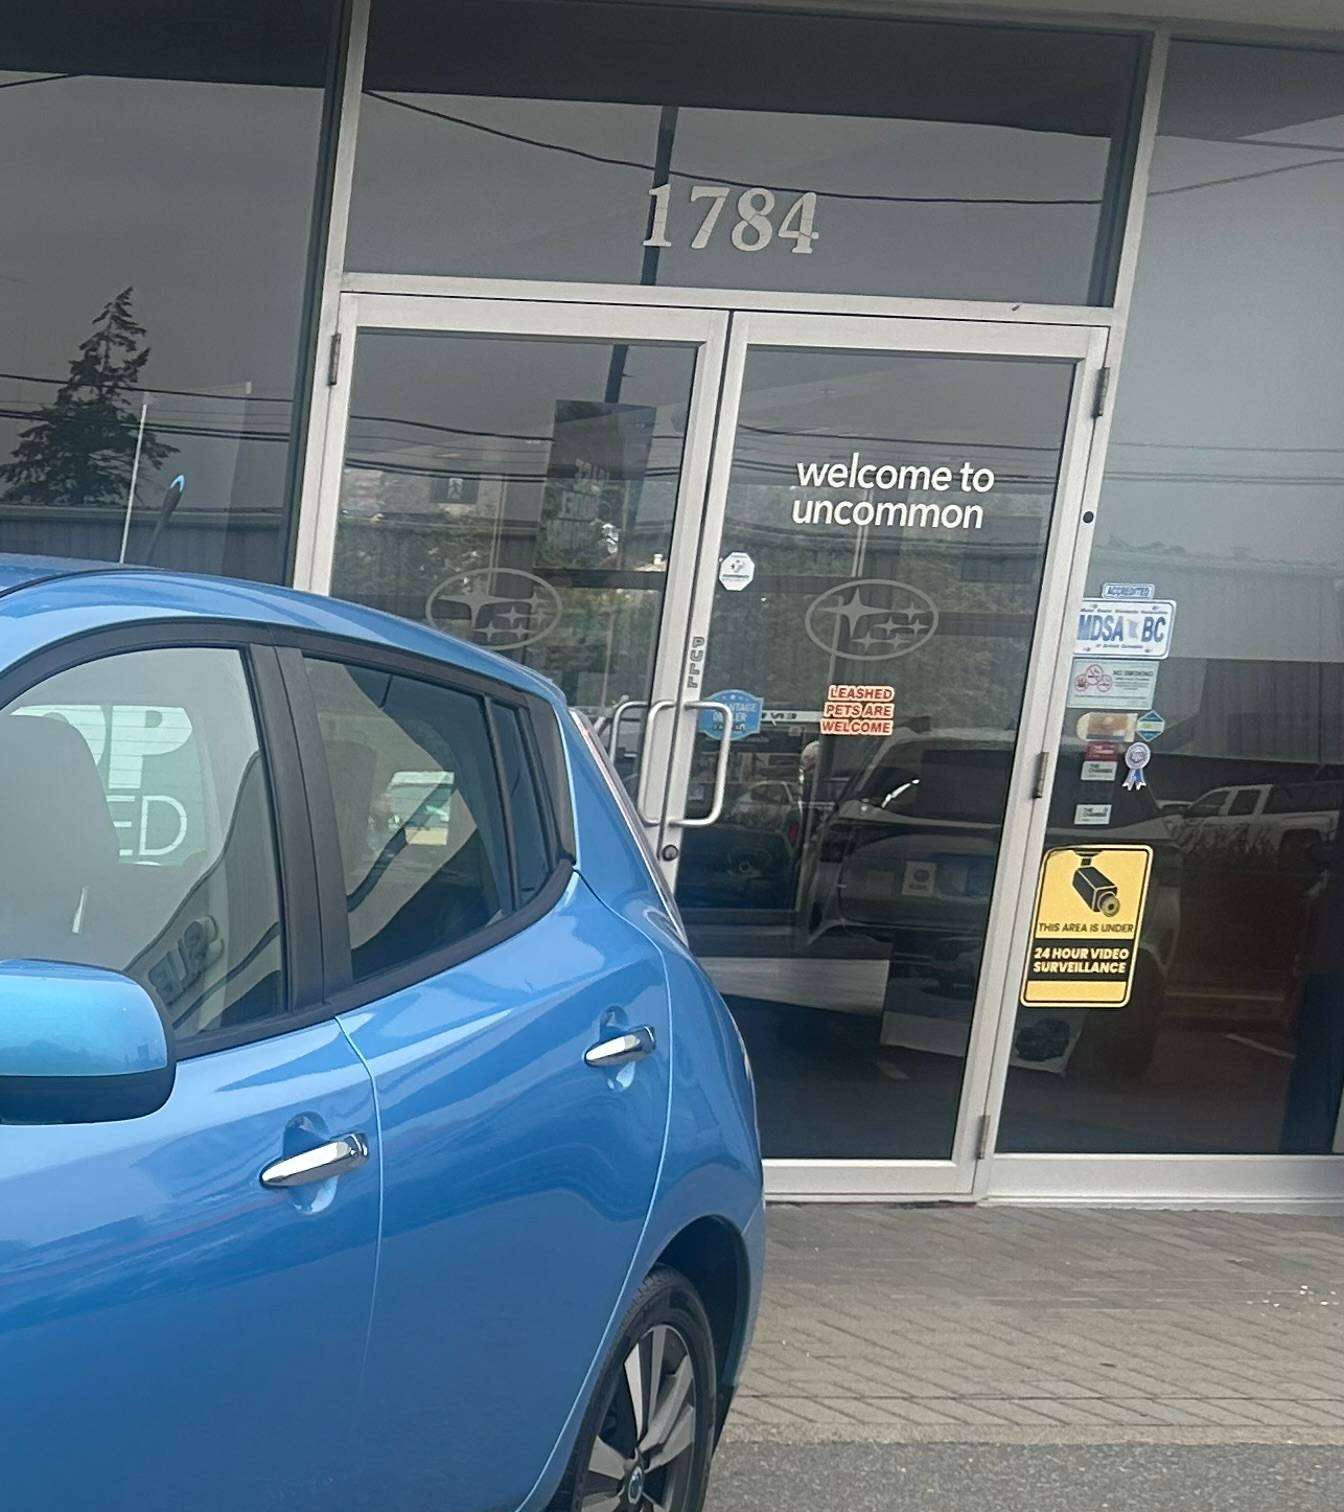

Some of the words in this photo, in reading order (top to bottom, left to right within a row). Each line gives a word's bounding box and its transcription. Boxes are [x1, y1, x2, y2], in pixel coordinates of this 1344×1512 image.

[642, 183, 820, 254] 1784
[796, 451, 953, 492] welcome
[960, 461, 995, 493] to
[791, 499, 984, 529] uncommon
[1077, 614, 1124, 641] MDSA
[1141, 616, 1166, 642] BC
[829, 686, 894, 700] LEASHED
[825, 703, 861, 717] PETS
[862, 703, 893, 717] ARE
[821, 719, 892, 734] WELCOME
[1038, 922, 1060, 933] THIS
[1062, 922, 1088, 933] AREA
[1089, 922, 1099, 933] IS
[1100, 923, 1135, 934] UNDER
[1033, 947, 1051, 960] 24
[1051, 947, 1089, 960] HOUR
[1089, 948, 1130, 960] VIDEO
[1033, 961, 1127, 974] SURVEILLANCE
